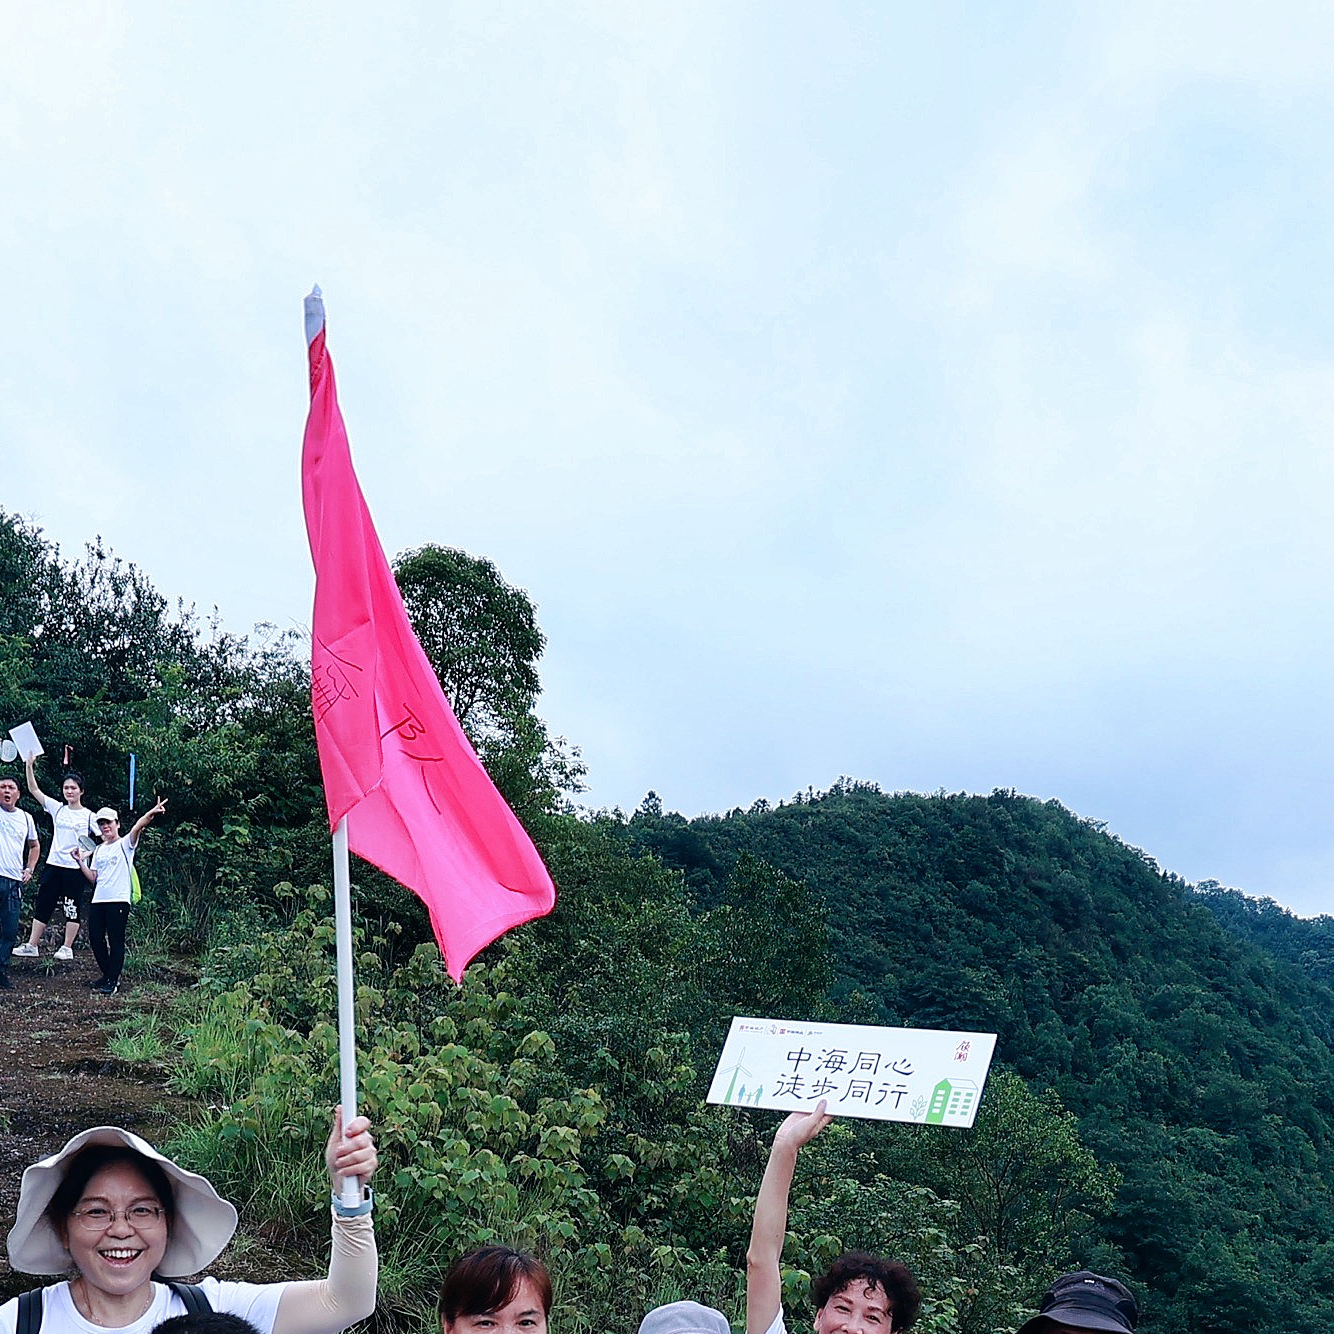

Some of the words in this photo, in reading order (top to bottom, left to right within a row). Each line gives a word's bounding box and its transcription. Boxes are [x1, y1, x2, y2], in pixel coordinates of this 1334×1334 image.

[786, 1046, 915, 1076] 中海同心
[772, 1072, 909, 1109] 徒步同行
